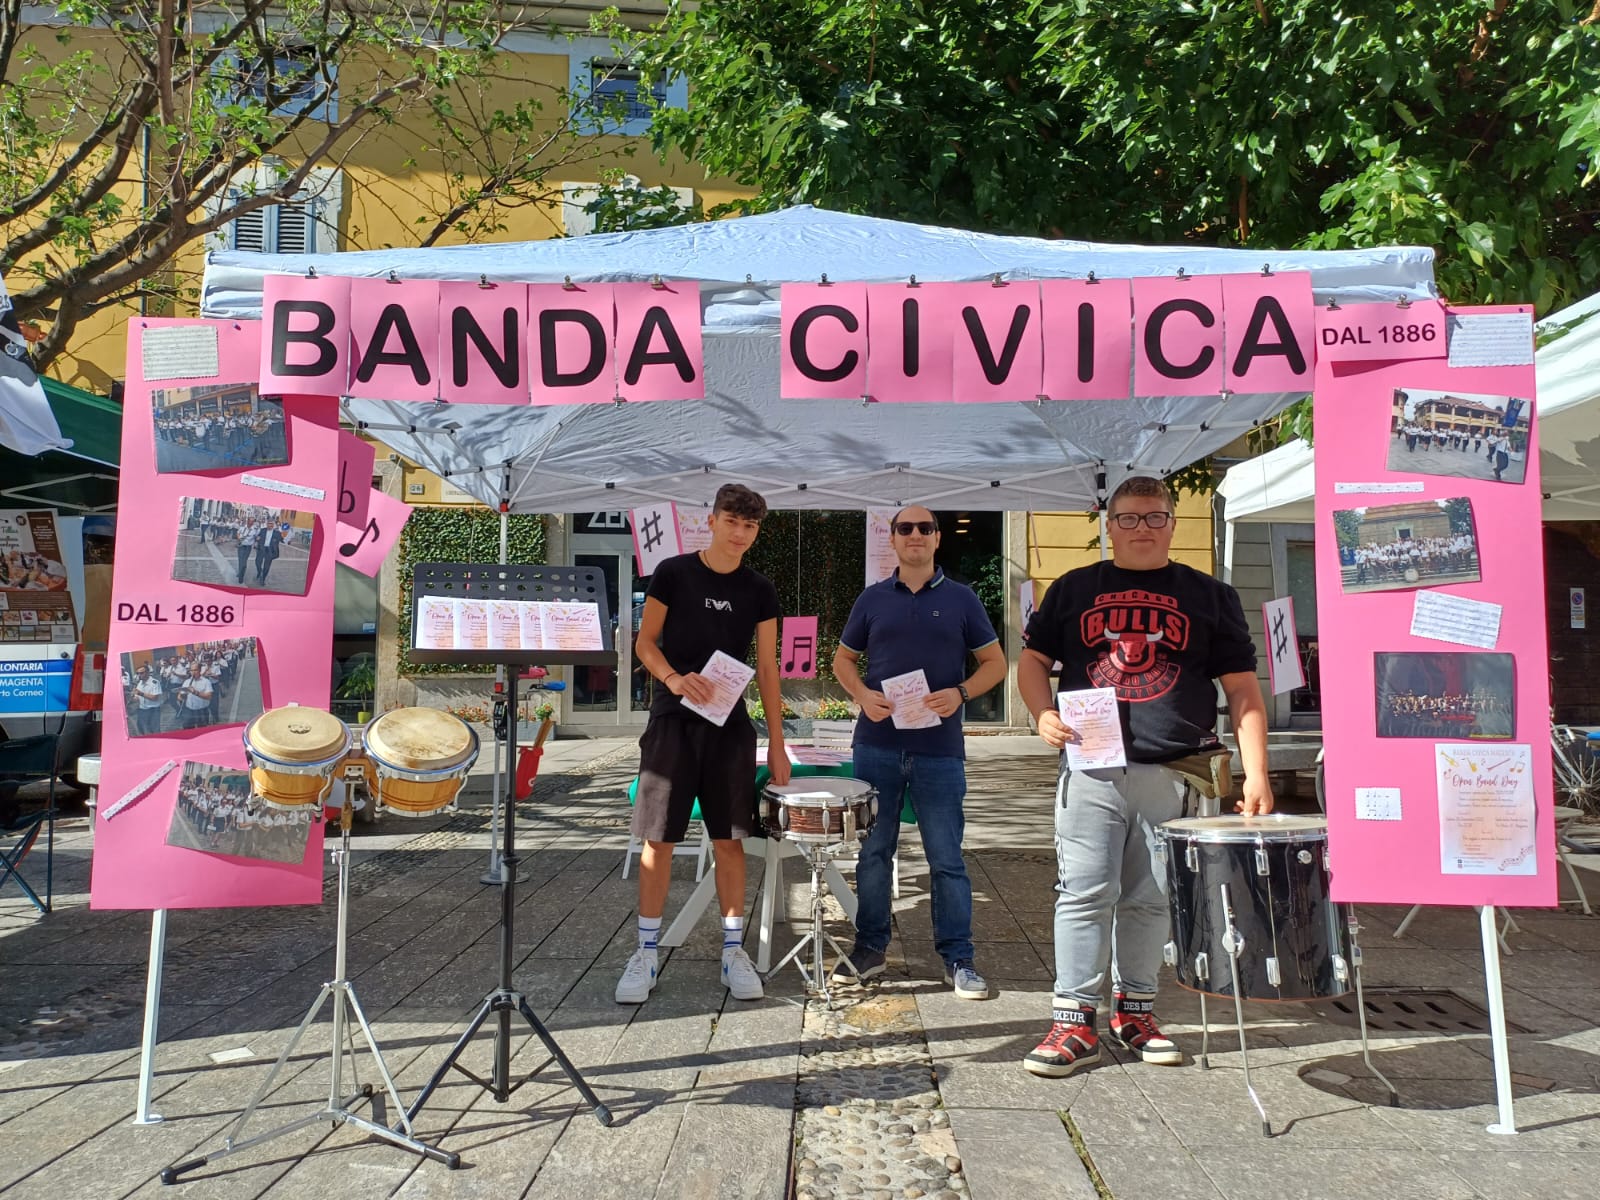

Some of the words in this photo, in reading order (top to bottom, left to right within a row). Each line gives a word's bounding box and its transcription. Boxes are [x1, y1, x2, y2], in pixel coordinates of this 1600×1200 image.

[286, 301, 696, 389] BANDA
[789, 295, 1307, 386] CIVICA
[1322, 326, 1372, 346] DAL
[1378, 323, 1436, 344] 1886
[1098, 590, 1173, 605] CHICAGO
[117, 602, 168, 622] DAL
[176, 604, 235, 624] 1886
[1087, 609, 1182, 642] BULLS
[0, 677, 44, 687] MAGENTA
[1452, 774, 1472, 787] Open
[1476, 774, 1498, 788] Band
[1501, 775, 1518, 789] Day
